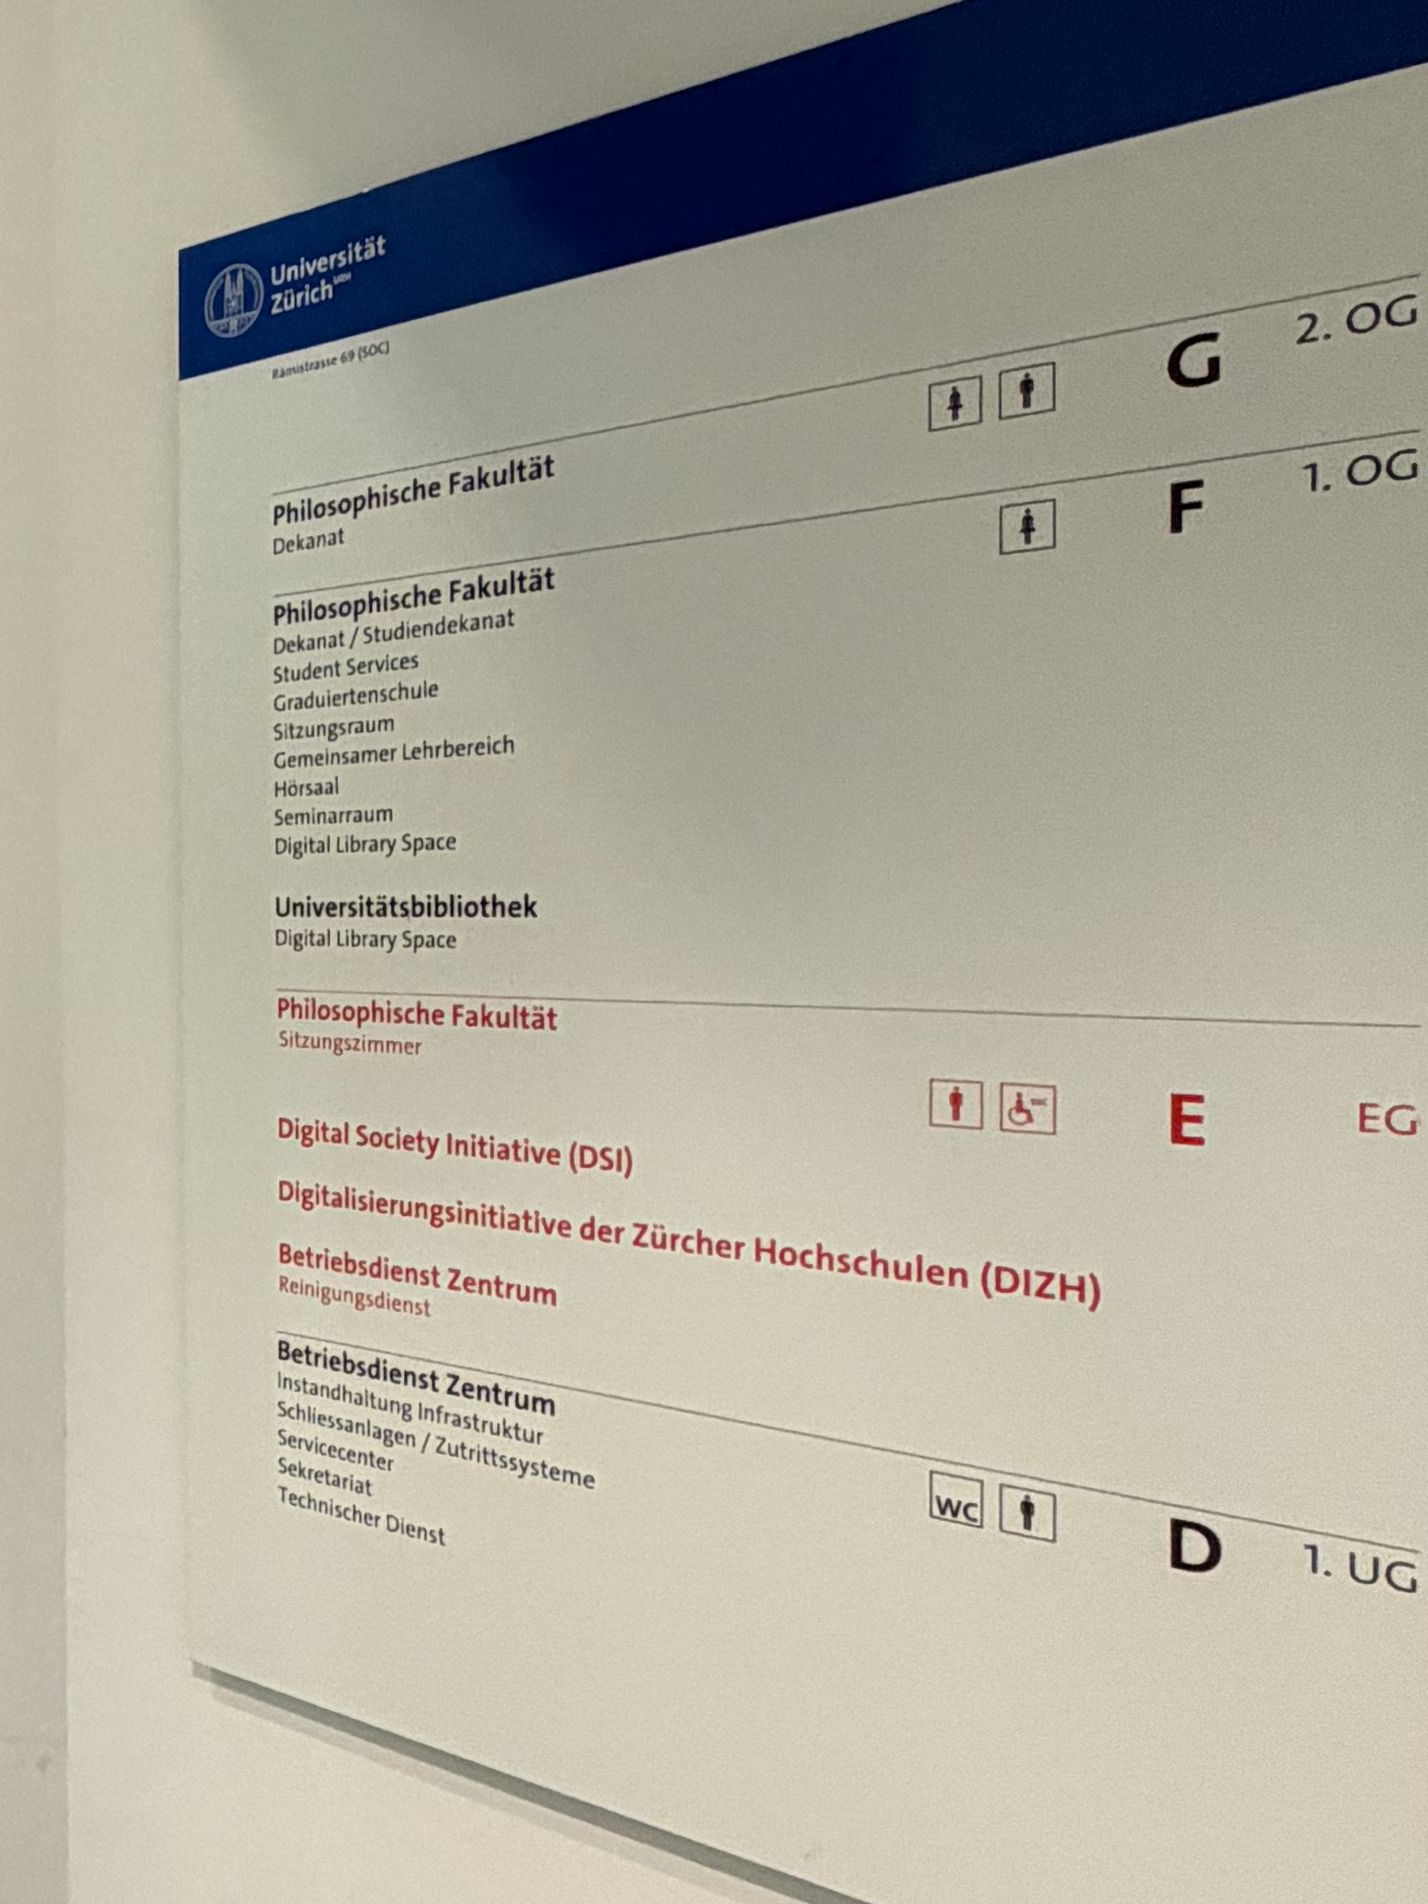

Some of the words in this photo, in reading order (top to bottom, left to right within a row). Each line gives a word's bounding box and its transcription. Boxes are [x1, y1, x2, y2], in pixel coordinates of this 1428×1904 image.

[271, 235, 386, 285] Universität
[271, 279, 333, 315] Zürich
[1296, 313, 1332, 345] 2.
[1345, 294, 1417, 334] OG
[272, 354, 337, 379] Rämistrasse
[341, 351, 354, 363] 69
[358, 340, 389, 361] (SOC)
[1167, 332, 1221, 388] G
[274, 479, 442, 526] Philosophische
[449, 455, 554, 494] Fakultät
[1302, 462, 1332, 492] 1.
[1346, 448, 1419, 486] OG
[1170, 480, 1204, 534] F
[273, 528, 344, 555] Dekanat
[274, 585, 442, 625] Philosophische
[450, 567, 554, 602] Fakultät
[274, 632, 344, 654] Dekanat
[350, 627, 358, 649] /
[363, 609, 514, 644] Studiendekanat
[274, 660, 341, 684] Student
[346, 654, 419, 675] Services
[274, 681, 438, 712] Graduiertenschule
[274, 718, 394, 741] Sitzungsraum
[274, 747, 397, 768] Gemeinsamer
[403, 735, 514, 760] Lehrbereich
[274, 776, 339, 797] Hörsaal
[274, 807, 393, 826] Seminarraum
[275, 836, 330, 859] Digital
[336, 834, 396, 857] Library
[402, 834, 456, 855] Space
[276, 894, 538, 918] Universitätsbibliothek
[275, 929, 330, 951] Digital
[336, 930, 397, 953] Library
[402, 930, 456, 953] Space
[278, 998, 444, 1027] Philosophische
[452, 1004, 558, 1030] Fakultät
[279, 1031, 422, 1055] Sitzungszimmer
[1170, 1094, 1205, 1146] E
[1359, 1104, 1419, 1136] EG
[278, 1118, 349, 1148] Digital
[356, 1125, 439, 1159] Society
[446, 1133, 560, 1165] Initiative
[569, 1142, 633, 1179] (DSI)
[278, 1180, 572, 1238] Digitalisierungsinitiative
[580, 1216, 625, 1244] der
[632, 1222, 745, 1262] Zürcher
[754, 1237, 969, 1290] Hochschulen
[981, 1261, 1102, 1312] (DIZH)
[279, 1243, 440, 1288] Betriebsdienst
[448, 1268, 557, 1306] Zentrum
[279, 1276, 431, 1317] Reinigungsdienst
[278, 1340, 438, 1392] Betriebsdienst
[446, 1373, 555, 1416] Zentrum
[278, 1372, 412, 1421] Instandhaltung
[418, 1402, 544, 1445] Infrastruktur
[278, 1401, 416, 1448] Schliessanlagen
[420, 1433, 431, 1454] /
[435, 1436, 595, 1490] Zutrittssysteme
[278, 1429, 393, 1472] Servicecenter
[278, 1457, 372, 1496] Sekretariat
[279, 1485, 380, 1527] Technischer
[387, 1514, 446, 1547] Dienst
[936, 1497, 979, 1523] WC
[1169, 1518, 1222, 1573] D
[1304, 1544, 1333, 1578] 1.
[1350, 1551, 1419, 1595] UG
